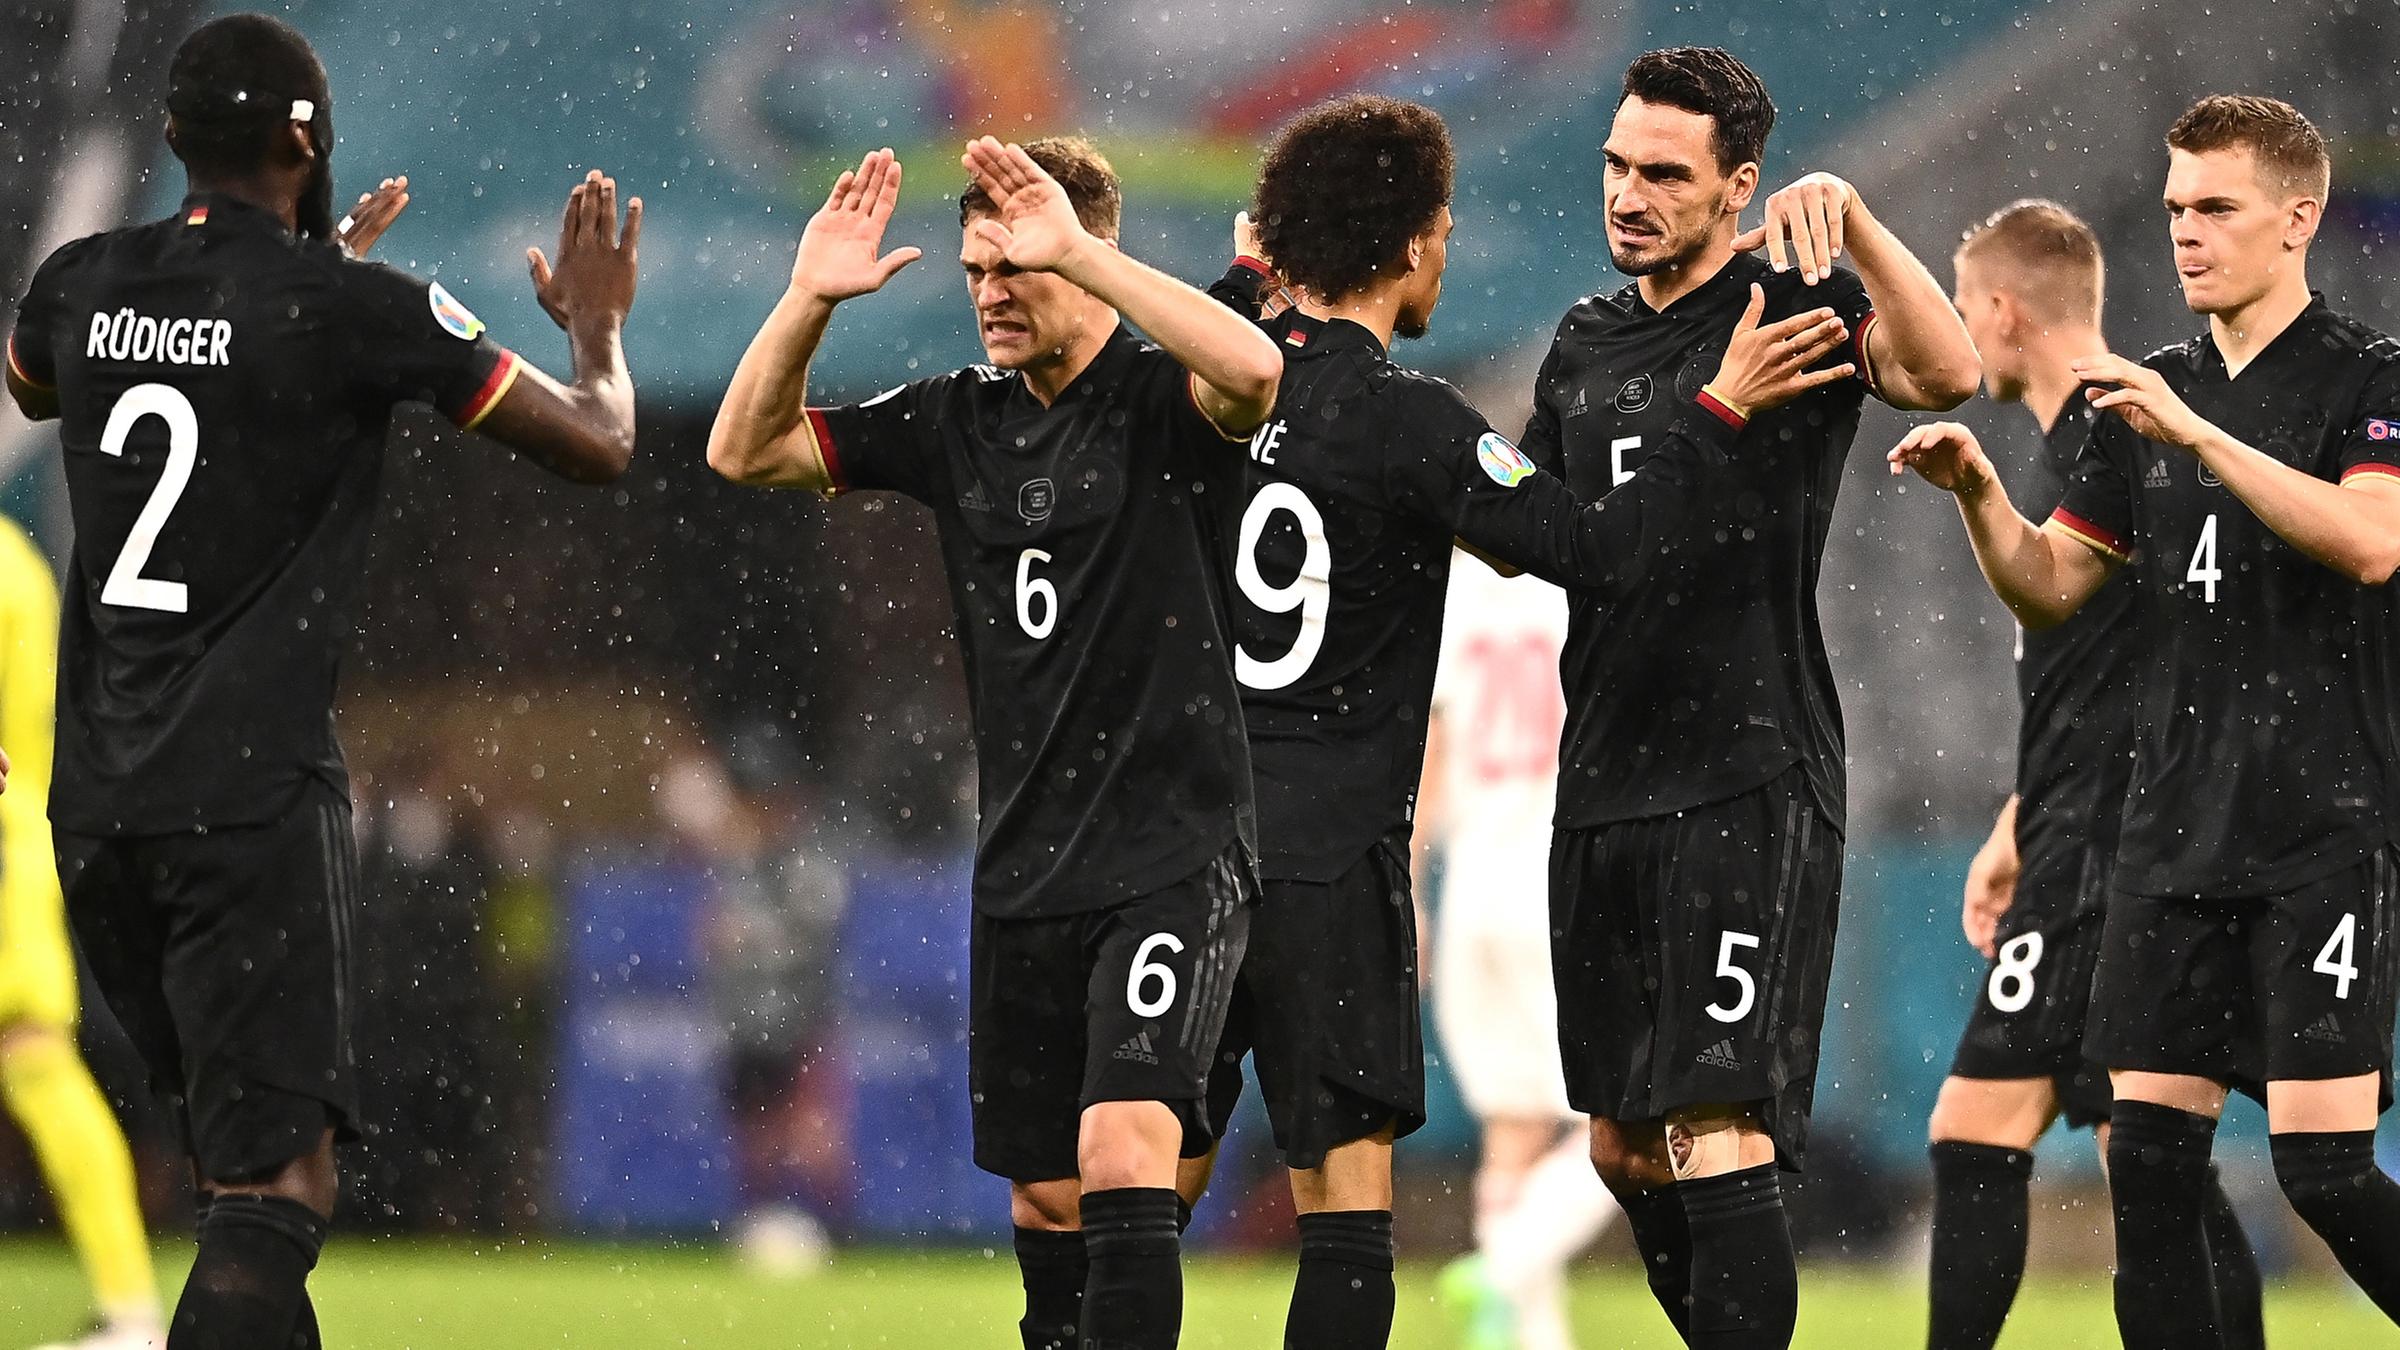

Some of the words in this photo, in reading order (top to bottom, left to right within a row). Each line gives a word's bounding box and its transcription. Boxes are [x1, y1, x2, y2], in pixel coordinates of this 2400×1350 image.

[87, 308, 231, 365] RÜDIGER
[100, 384, 198, 612] 2
[1016, 549, 1058, 640] 6
[1234, 482, 1332, 690] 9
[2187, 515, 2222, 603] 4
[1127, 933, 1184, 1018] 6
[1705, 931, 1759, 1022] 5
[1989, 932, 2044, 1012] 8
[2313, 913, 2359, 999] 4
[1113, 1049, 1159, 1066] adidas
[1696, 1053, 1741, 1072] adidas
